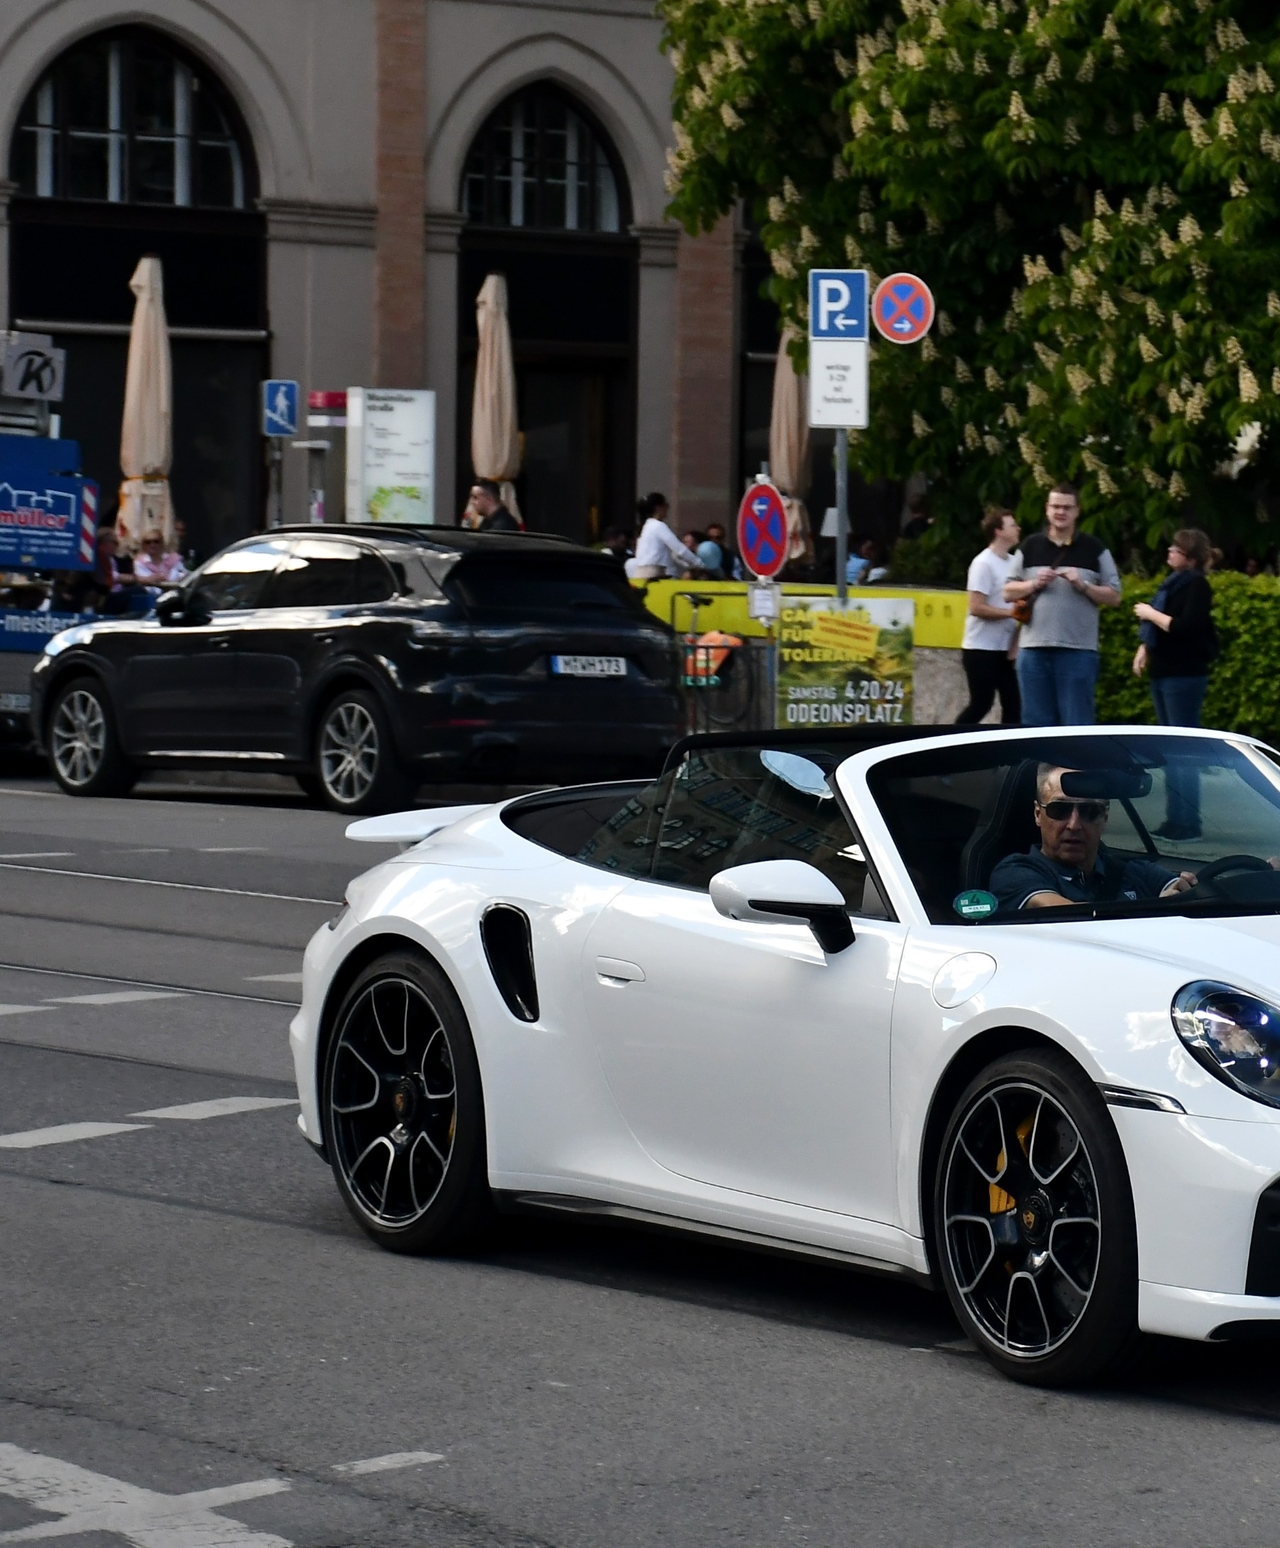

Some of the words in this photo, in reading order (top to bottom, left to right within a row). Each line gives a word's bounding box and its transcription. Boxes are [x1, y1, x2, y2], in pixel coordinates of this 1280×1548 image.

[818, 279, 850, 330] P
[787, 687, 837, 700] SAMSTAG
[786, 703, 904, 723] ODEONSPLATZ
